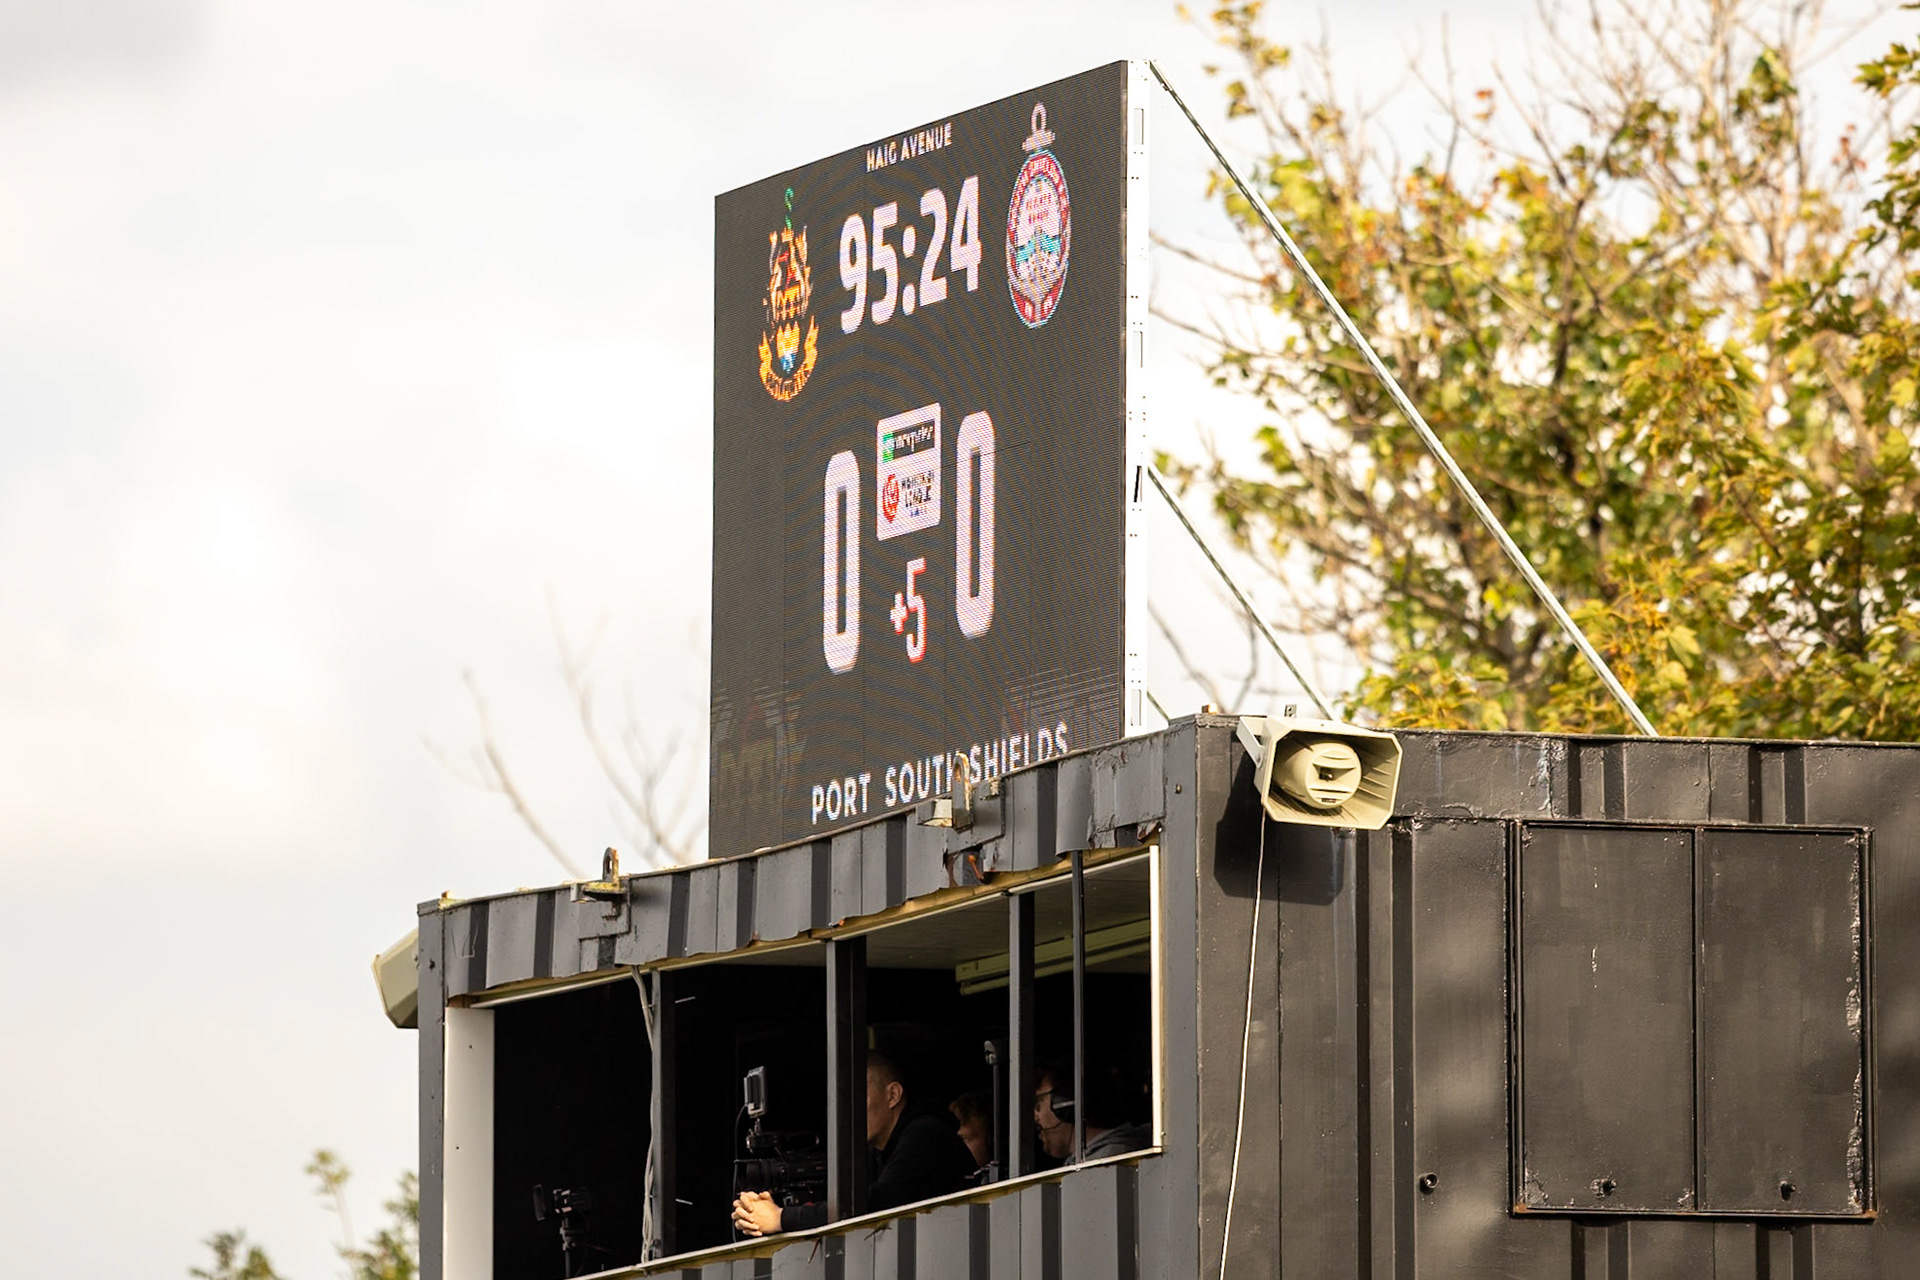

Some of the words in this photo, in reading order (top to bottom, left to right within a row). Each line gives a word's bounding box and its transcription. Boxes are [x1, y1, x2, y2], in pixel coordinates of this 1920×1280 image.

[866, 141, 897, 173] HAIG
[900, 122, 952, 161] AVENUE
[839, 175, 983, 334] 95:24
[823, 449, 860, 675] 0
[955, 410, 995, 640] 0
[890, 557, 927, 663] +5
[811, 773, 871, 825] PORT
[969, 721, 1068, 784] SHIELDS
